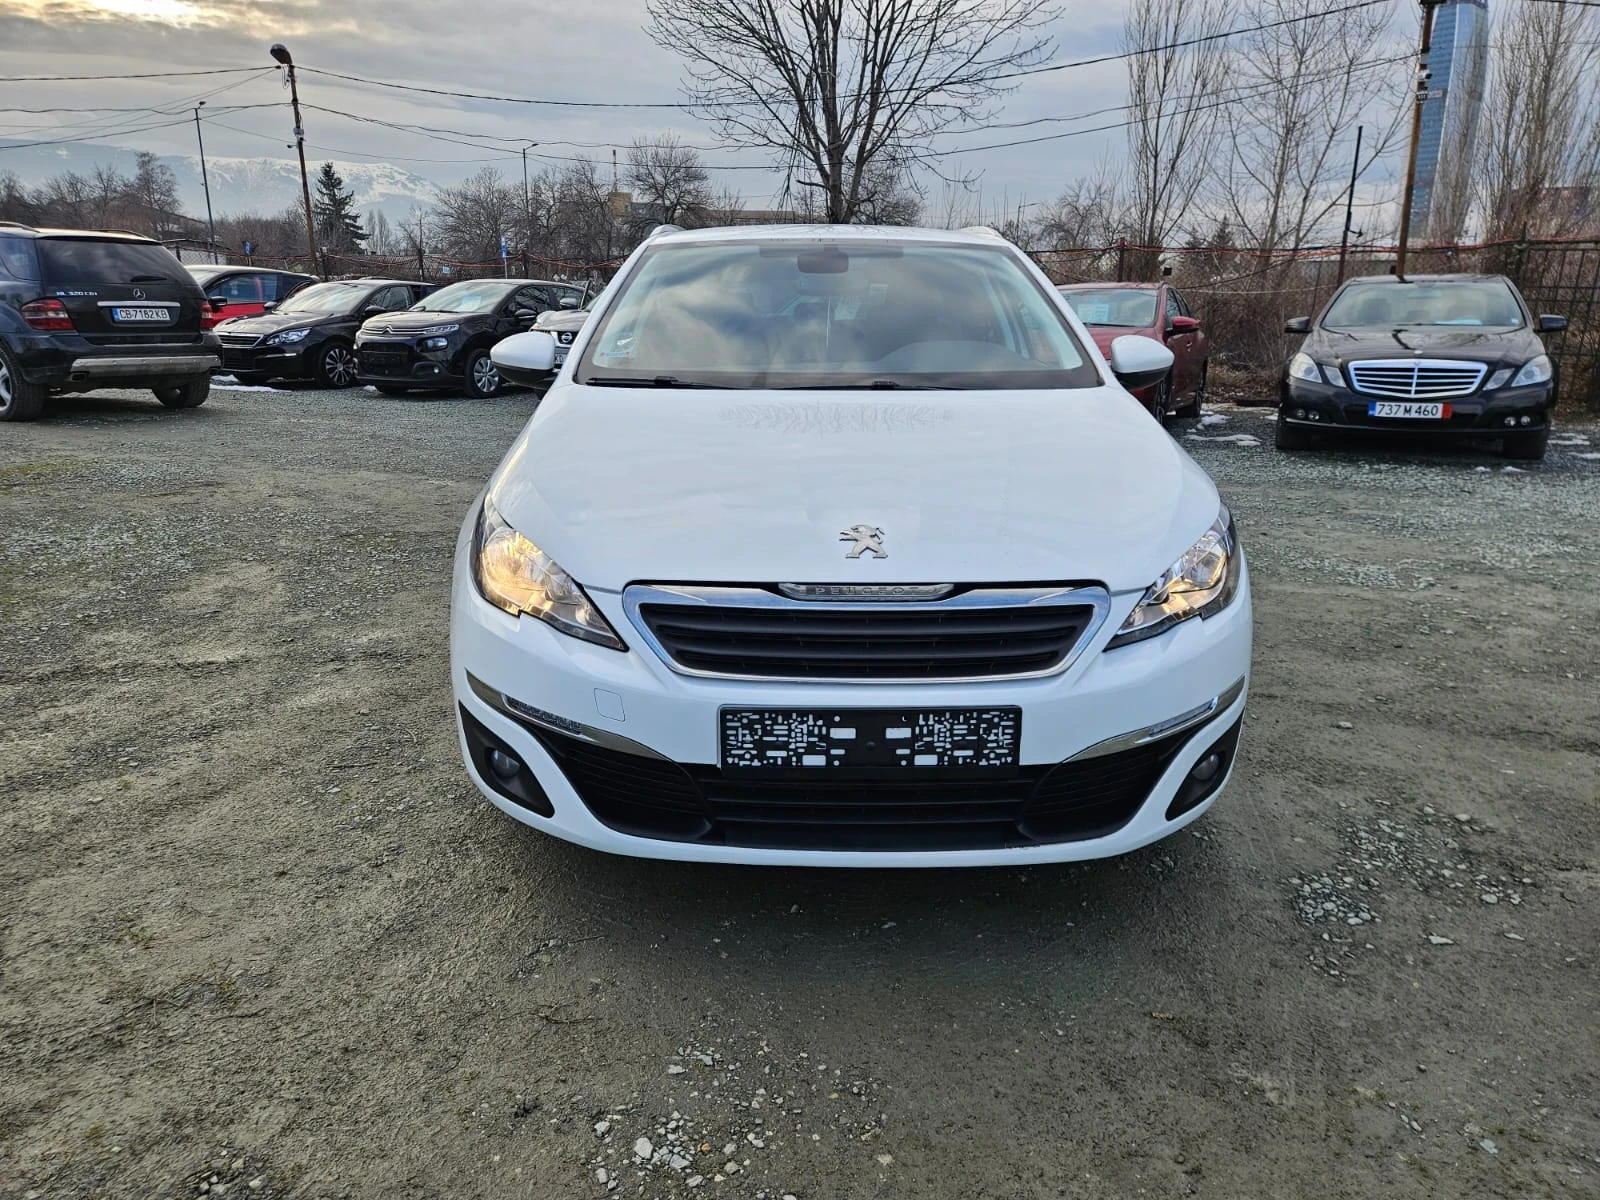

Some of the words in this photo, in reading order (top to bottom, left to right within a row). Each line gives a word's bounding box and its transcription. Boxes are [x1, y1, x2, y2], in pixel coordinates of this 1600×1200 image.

[1377, 403, 1401, 416] 737
[1403, 404, 1412, 416] M
[1415, 404, 1438, 416] 460
[815, 585, 919, 595] PEUGEOT
